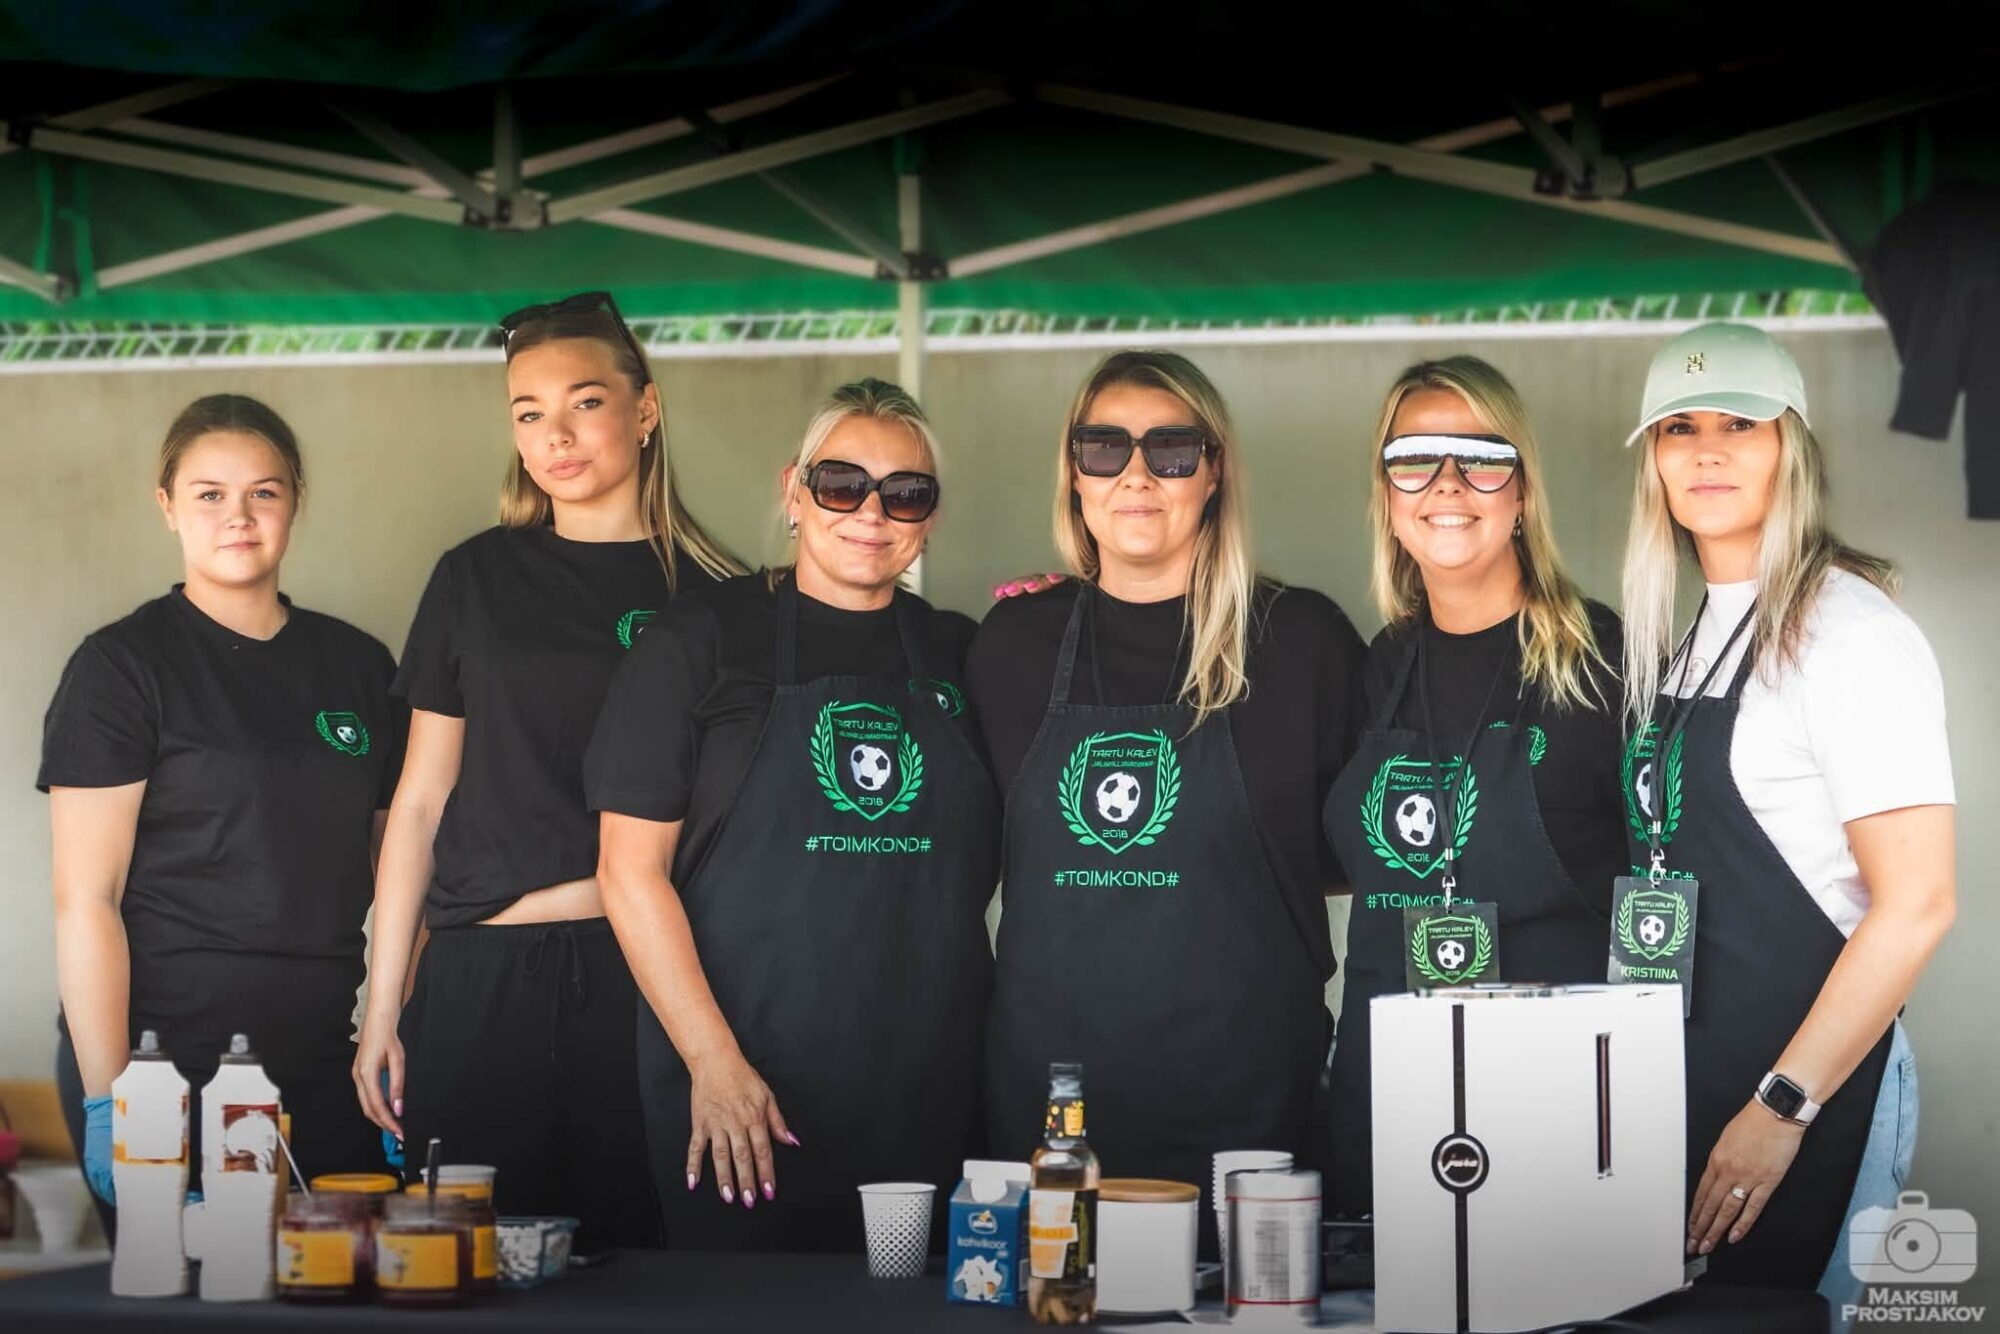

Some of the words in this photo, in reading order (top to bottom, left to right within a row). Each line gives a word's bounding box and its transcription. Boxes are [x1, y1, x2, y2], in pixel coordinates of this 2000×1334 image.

[867, 720, 898, 731] KALEV
[1091, 748, 1123, 758] TARTU
[1127, 747, 1158, 758] KALEV
[805, 836, 932, 853] #TOIMKOND#
[1054, 870, 1180, 887] #TOIMKOND#
[1620, 966, 1678, 980] KRISTIINA
